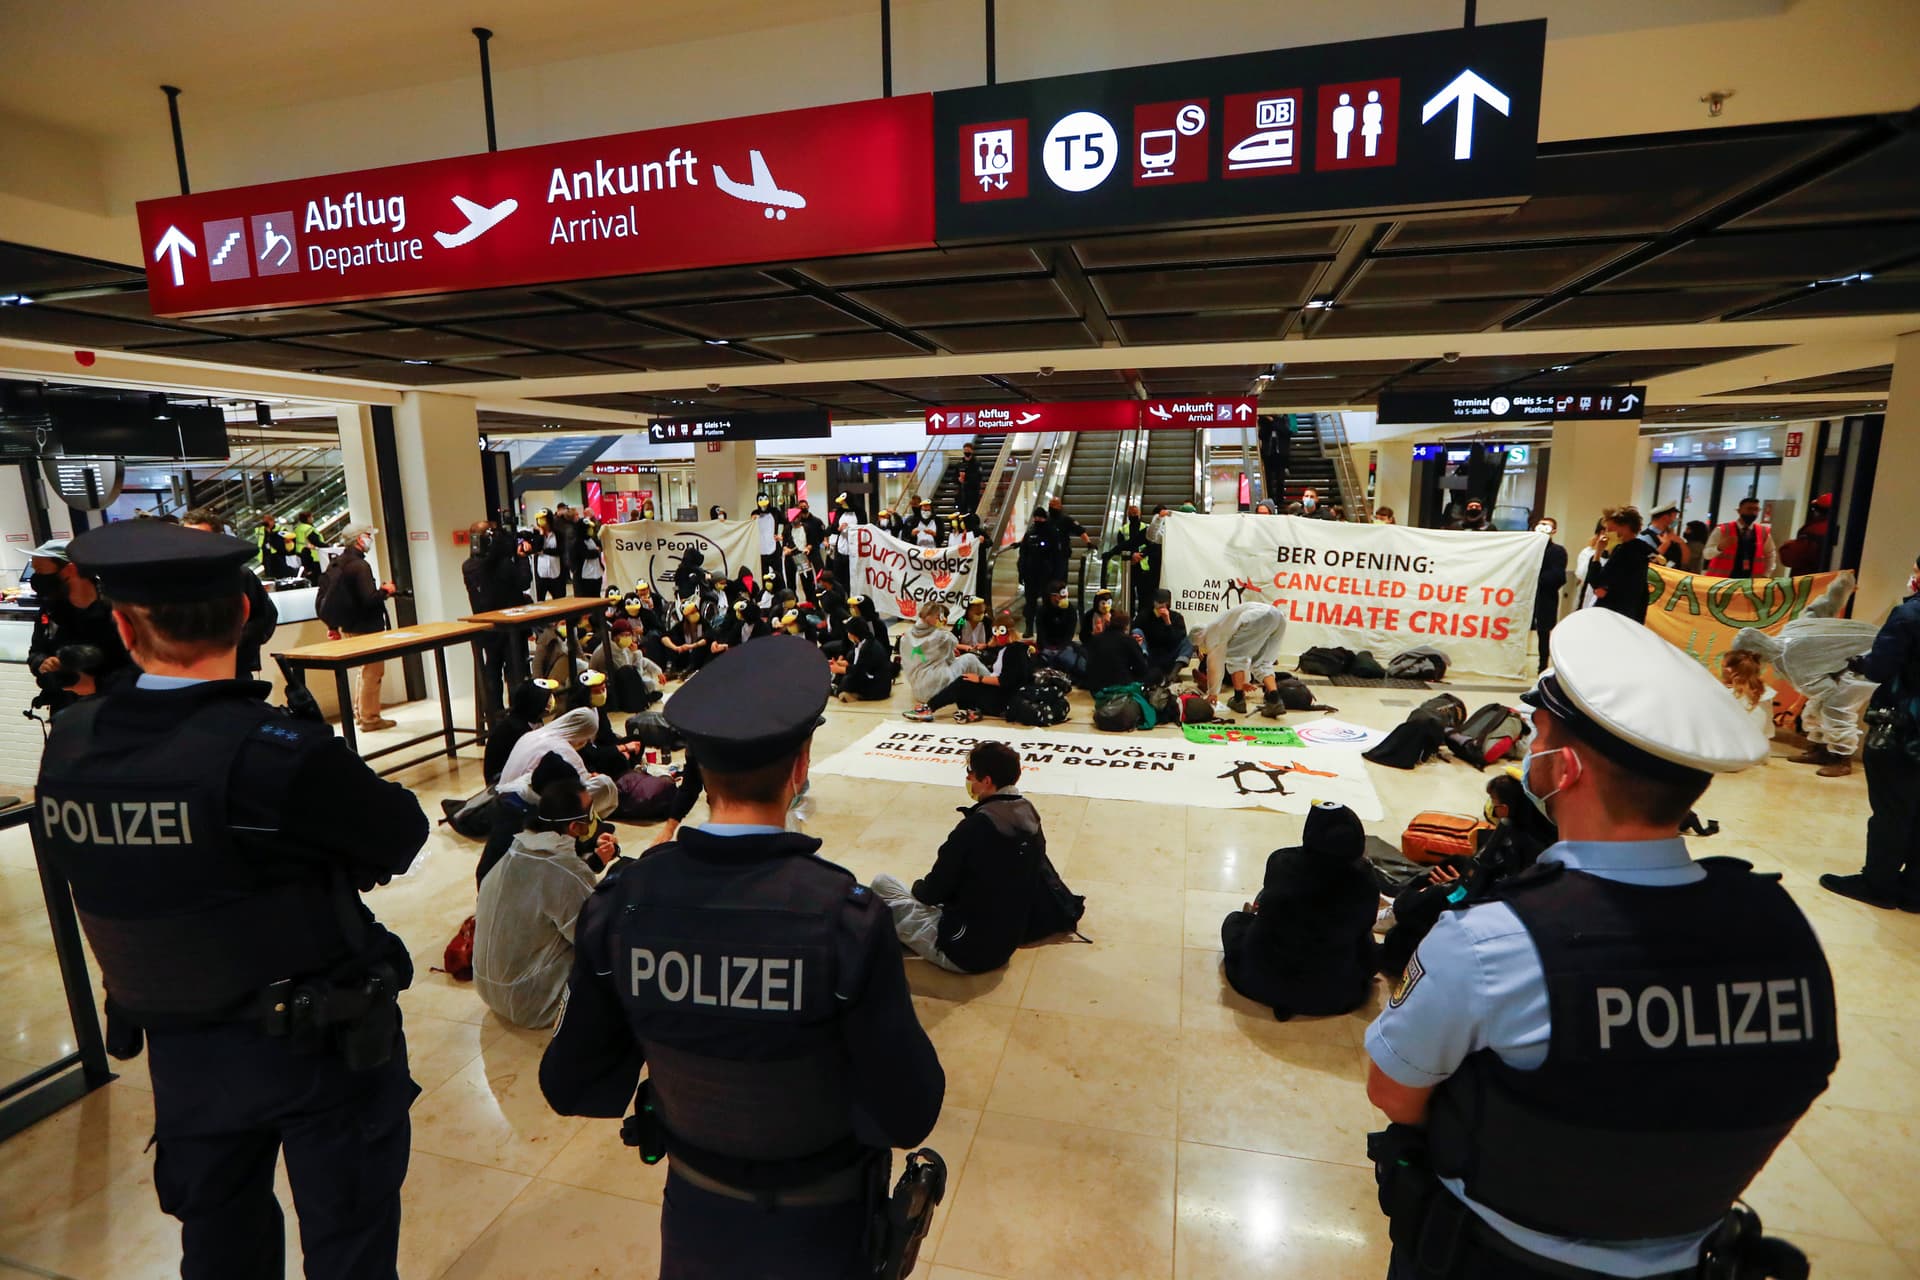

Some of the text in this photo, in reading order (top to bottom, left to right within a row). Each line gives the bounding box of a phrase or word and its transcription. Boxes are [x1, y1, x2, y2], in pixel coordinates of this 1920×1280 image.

[1182, 108, 1200, 131] S
[1261, 103, 1290, 124] DB
[1055, 132, 1105, 171] T5
[547, 148, 698, 203] Ankunft
[304, 192, 406, 233] Abflug
[550, 205, 639, 244] Arrival
[308, 238, 423, 275] Departure
[1172, 402, 1214, 413] Ankunft
[1453, 397, 1490, 406] Terminal
[1465, 407, 1489, 415] S-Bahn
[1513, 396, 1534, 405] Gleis
[1524, 406, 1554, 414] Platform
[978, 408, 1010, 420] Abflug
[978, 420, 1014, 429] Departure
[1188, 413, 1214, 422] Arrival
[1509, 447, 1523, 463] S
[615, 539, 652, 551] Save
[857, 527, 974, 575] Burn Borders
[1276, 546, 1435, 574] BER OPENING:
[865, 566, 970, 610] not Kerosene
[1182, 589, 1220, 601] BODEN
[1203, 579, 1220, 589] AM
[1273, 571, 1515, 607] CANCELLED DUE TO
[1175, 601, 1219, 613] BLEIBEN
[1408, 610, 1511, 641] CRISIS
[888, 732, 936, 742] DIE
[939, 737, 1093, 755] COSTEN
[876, 742, 971, 756] BLEIBE
[1062, 756, 1175, 772] BODEN
[42, 796, 192, 845] POLIZEI
[631, 947, 803, 1011] POLIZEI
[1596, 978, 1814, 1050] POLIZEI
